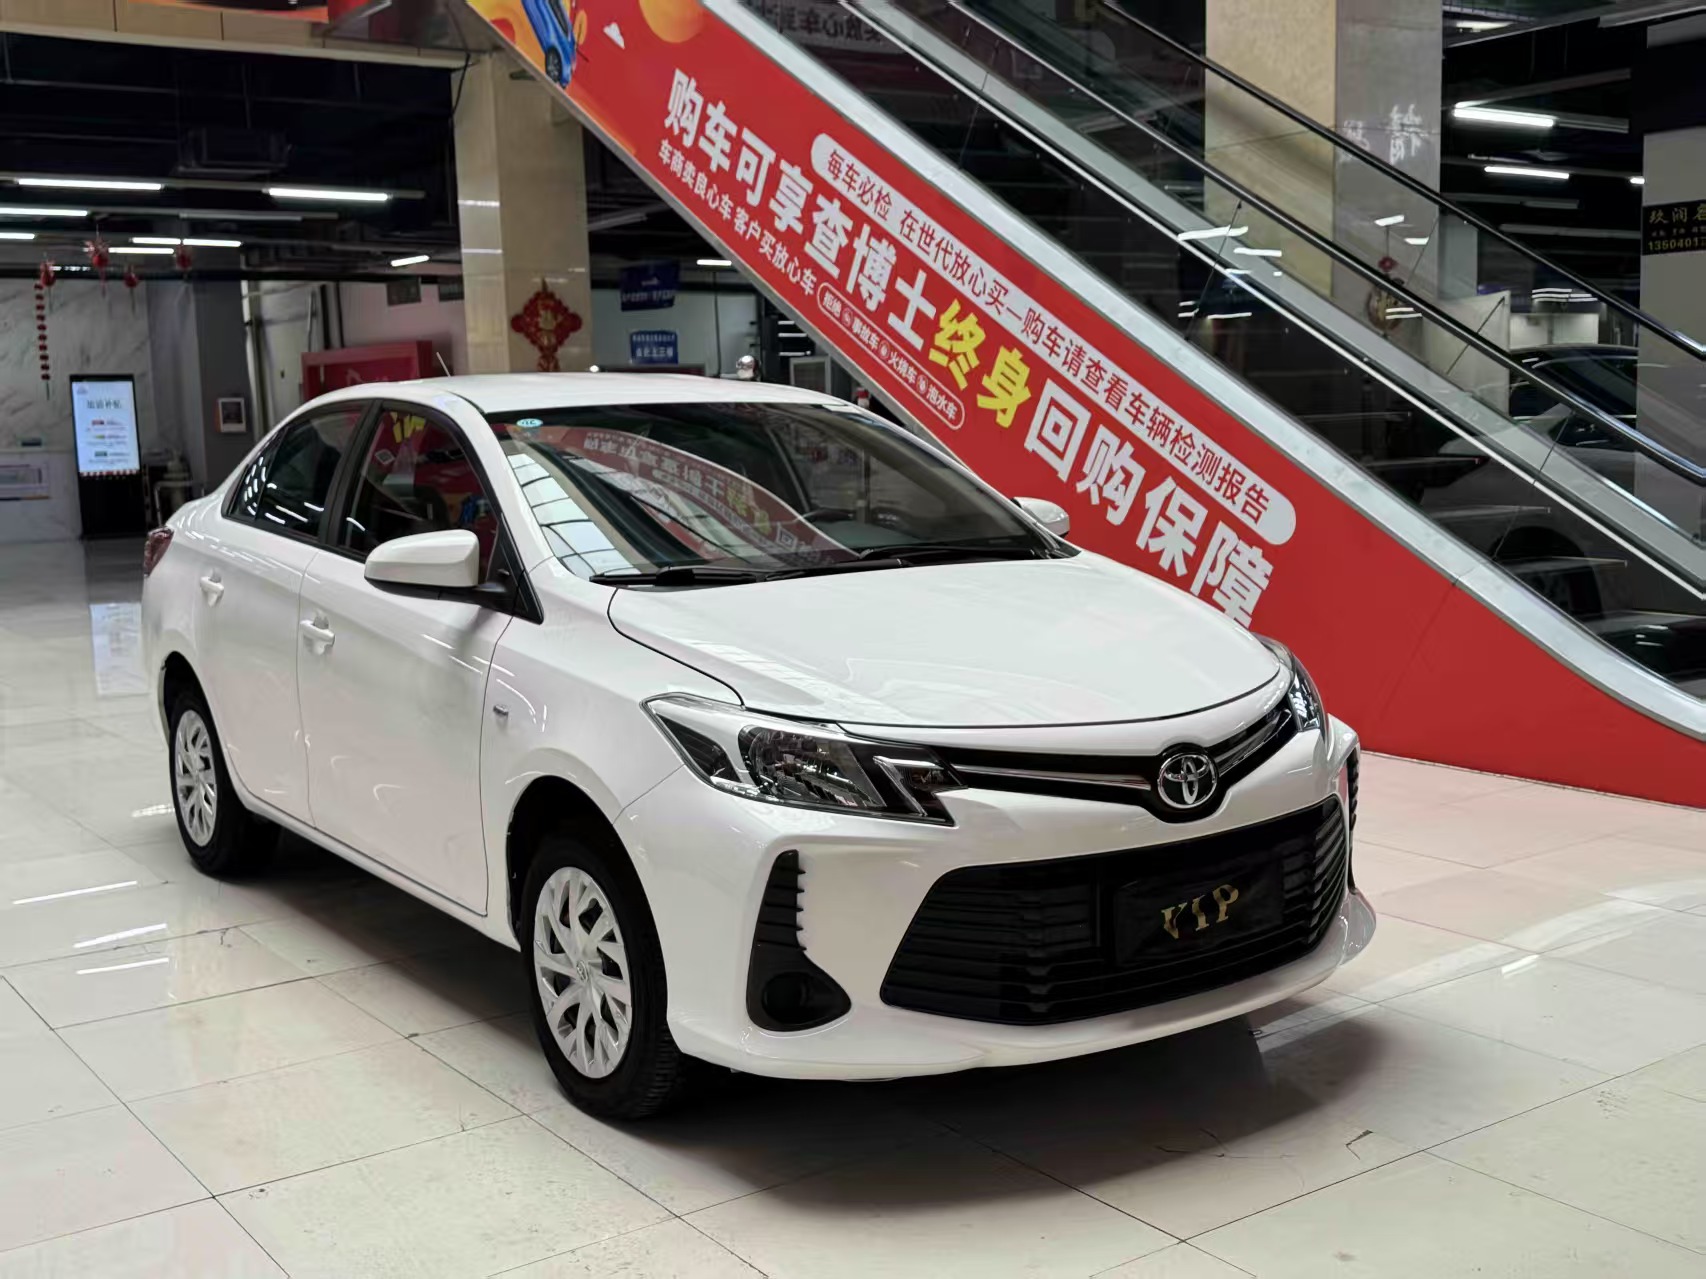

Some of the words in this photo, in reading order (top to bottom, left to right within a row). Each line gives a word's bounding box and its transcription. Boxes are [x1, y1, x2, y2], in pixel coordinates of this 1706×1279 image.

[658, 139, 734, 221] 车商卖良心车
[734, 206, 817, 295] 客户买放心车
[827, 149, 892, 222] 每车必检
[664, 68, 1274, 630] 购车可享查博士终身回购保障
[822, 292, 842, 316] 拒绝
[851, 317, 880, 350] 事故车
[888, 351, 918, 384] 火烧车
[926, 384, 958, 420] 泡水车
[1160, 883, 1240, 940] VIP
